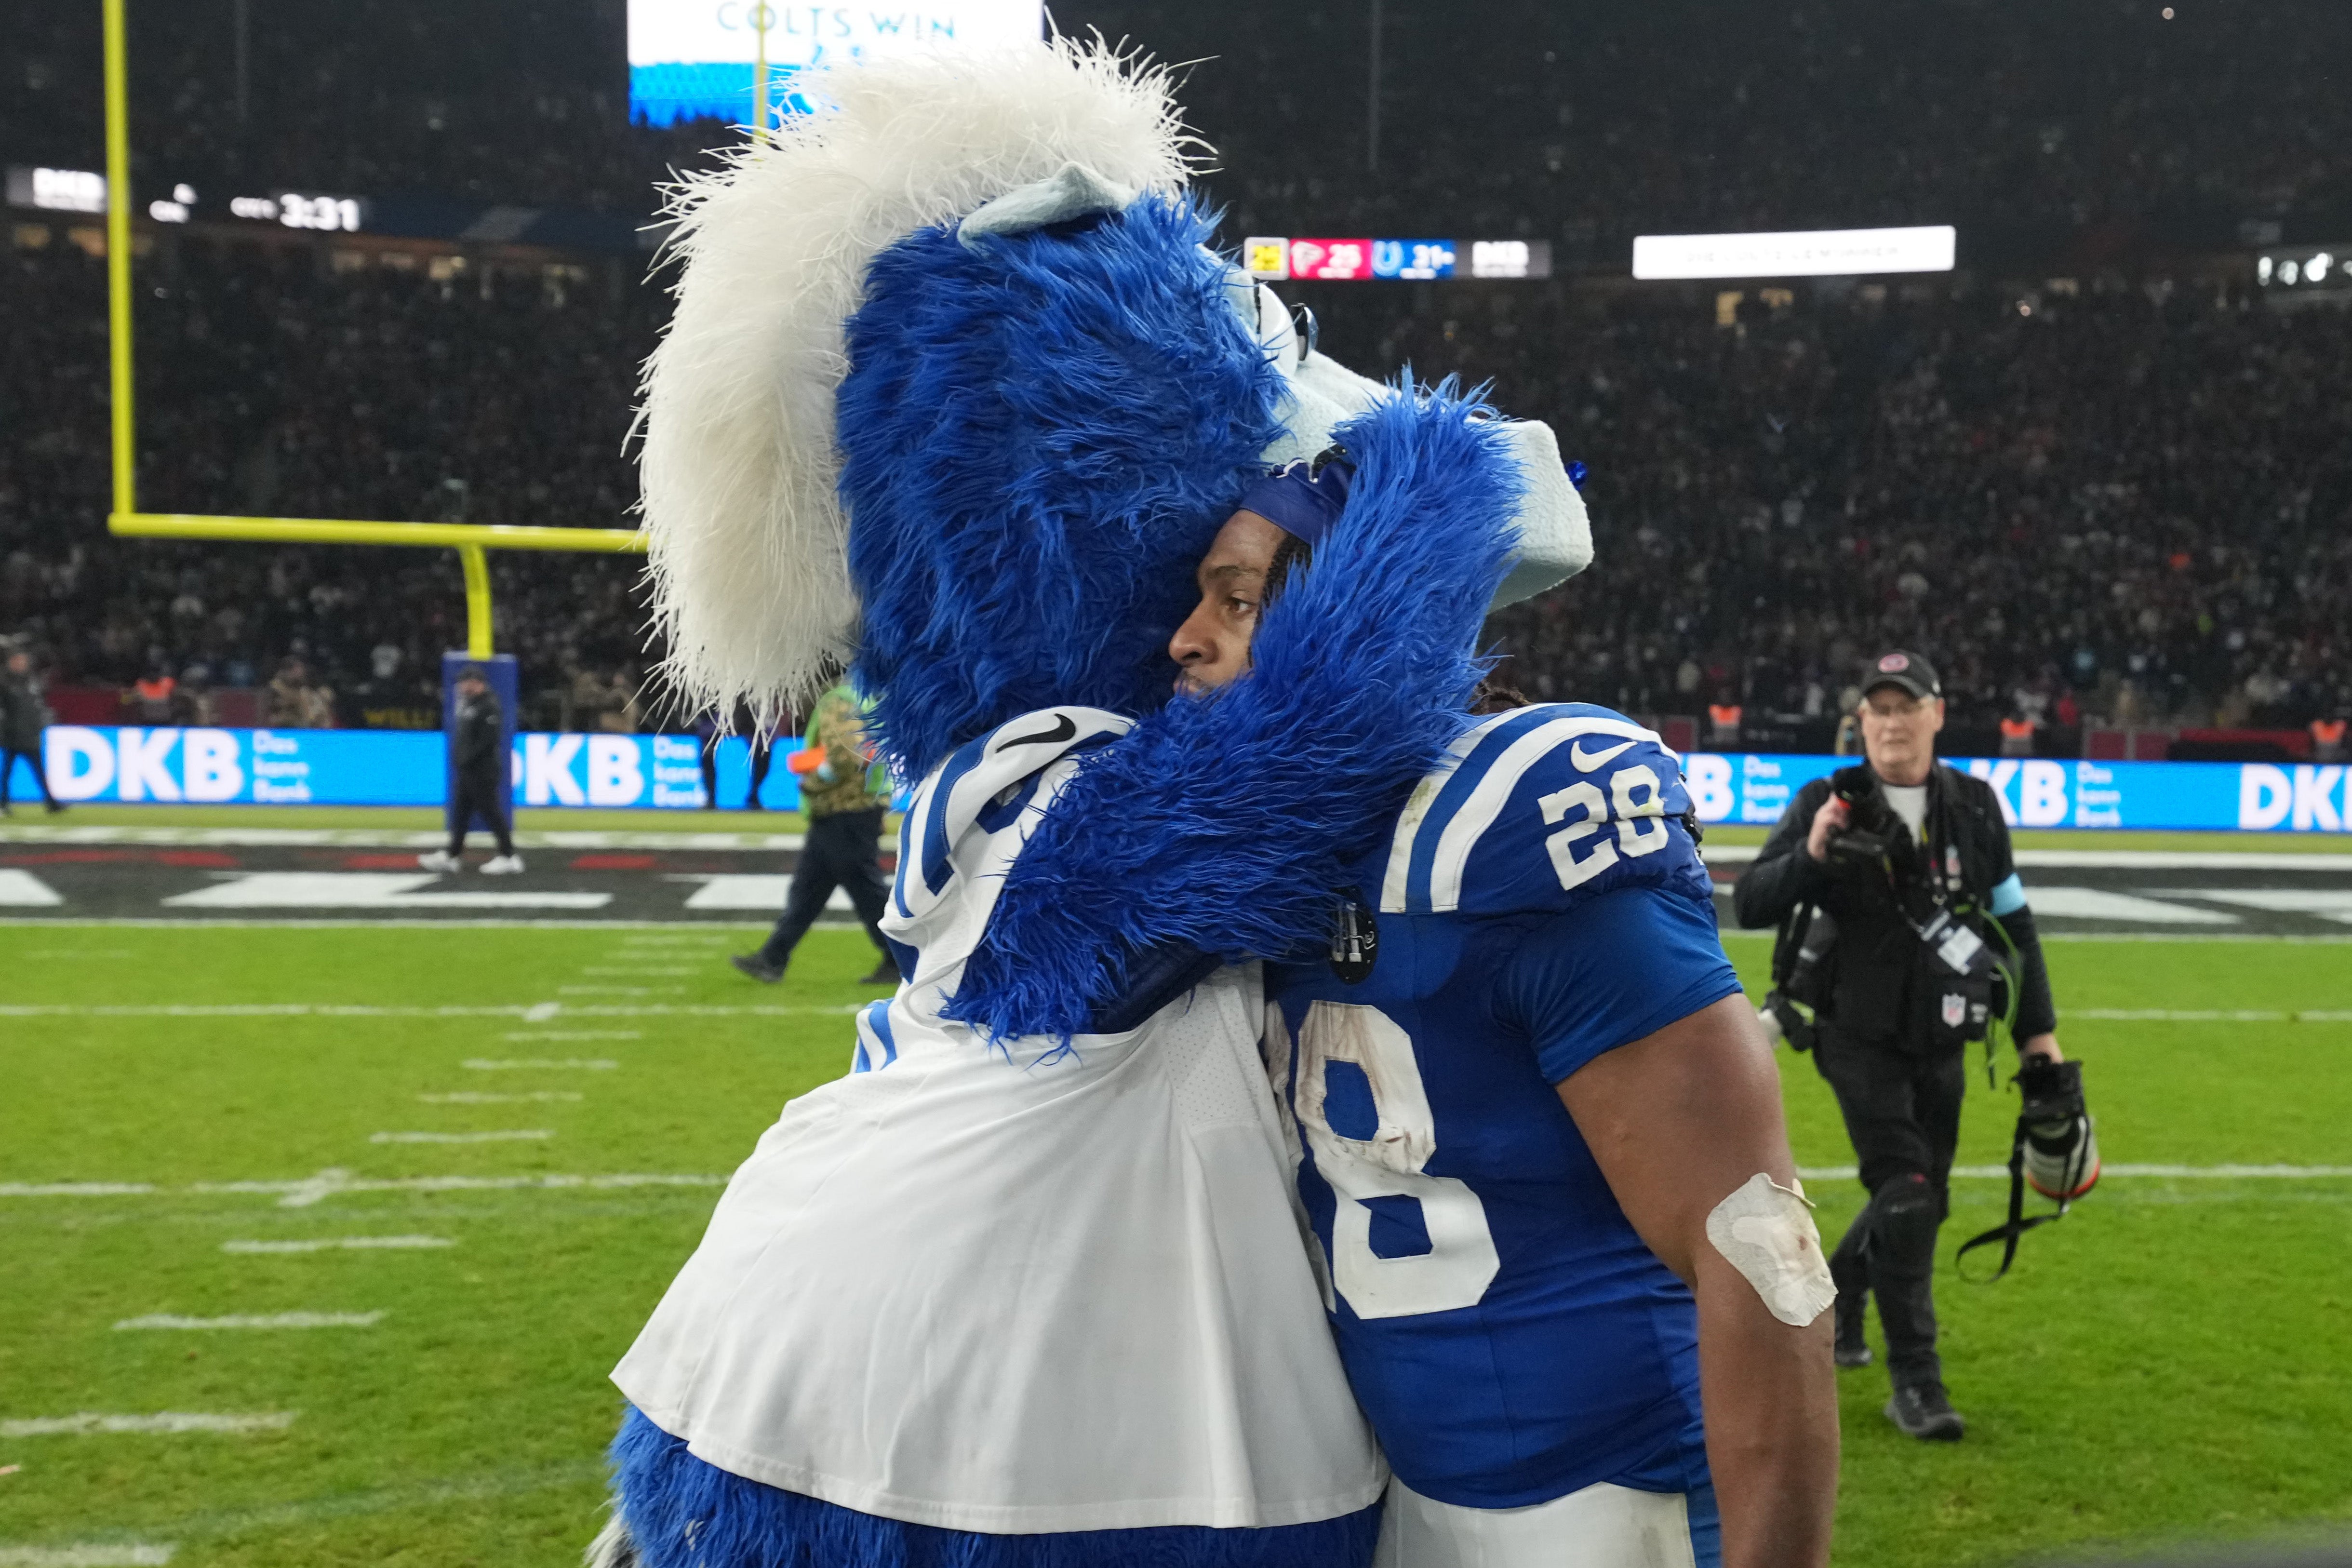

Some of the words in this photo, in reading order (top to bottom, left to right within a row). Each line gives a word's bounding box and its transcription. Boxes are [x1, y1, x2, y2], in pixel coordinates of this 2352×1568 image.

[717, 1, 852, 38] COLTS
[869, 12, 955, 39] WIN
[45, 726, 244, 802] DKB
[511, 732, 644, 806] KB
[1938, 758, 2069, 827] KB
[2239, 764, 2352, 832] DK
[1537, 764, 1669, 891] 28
